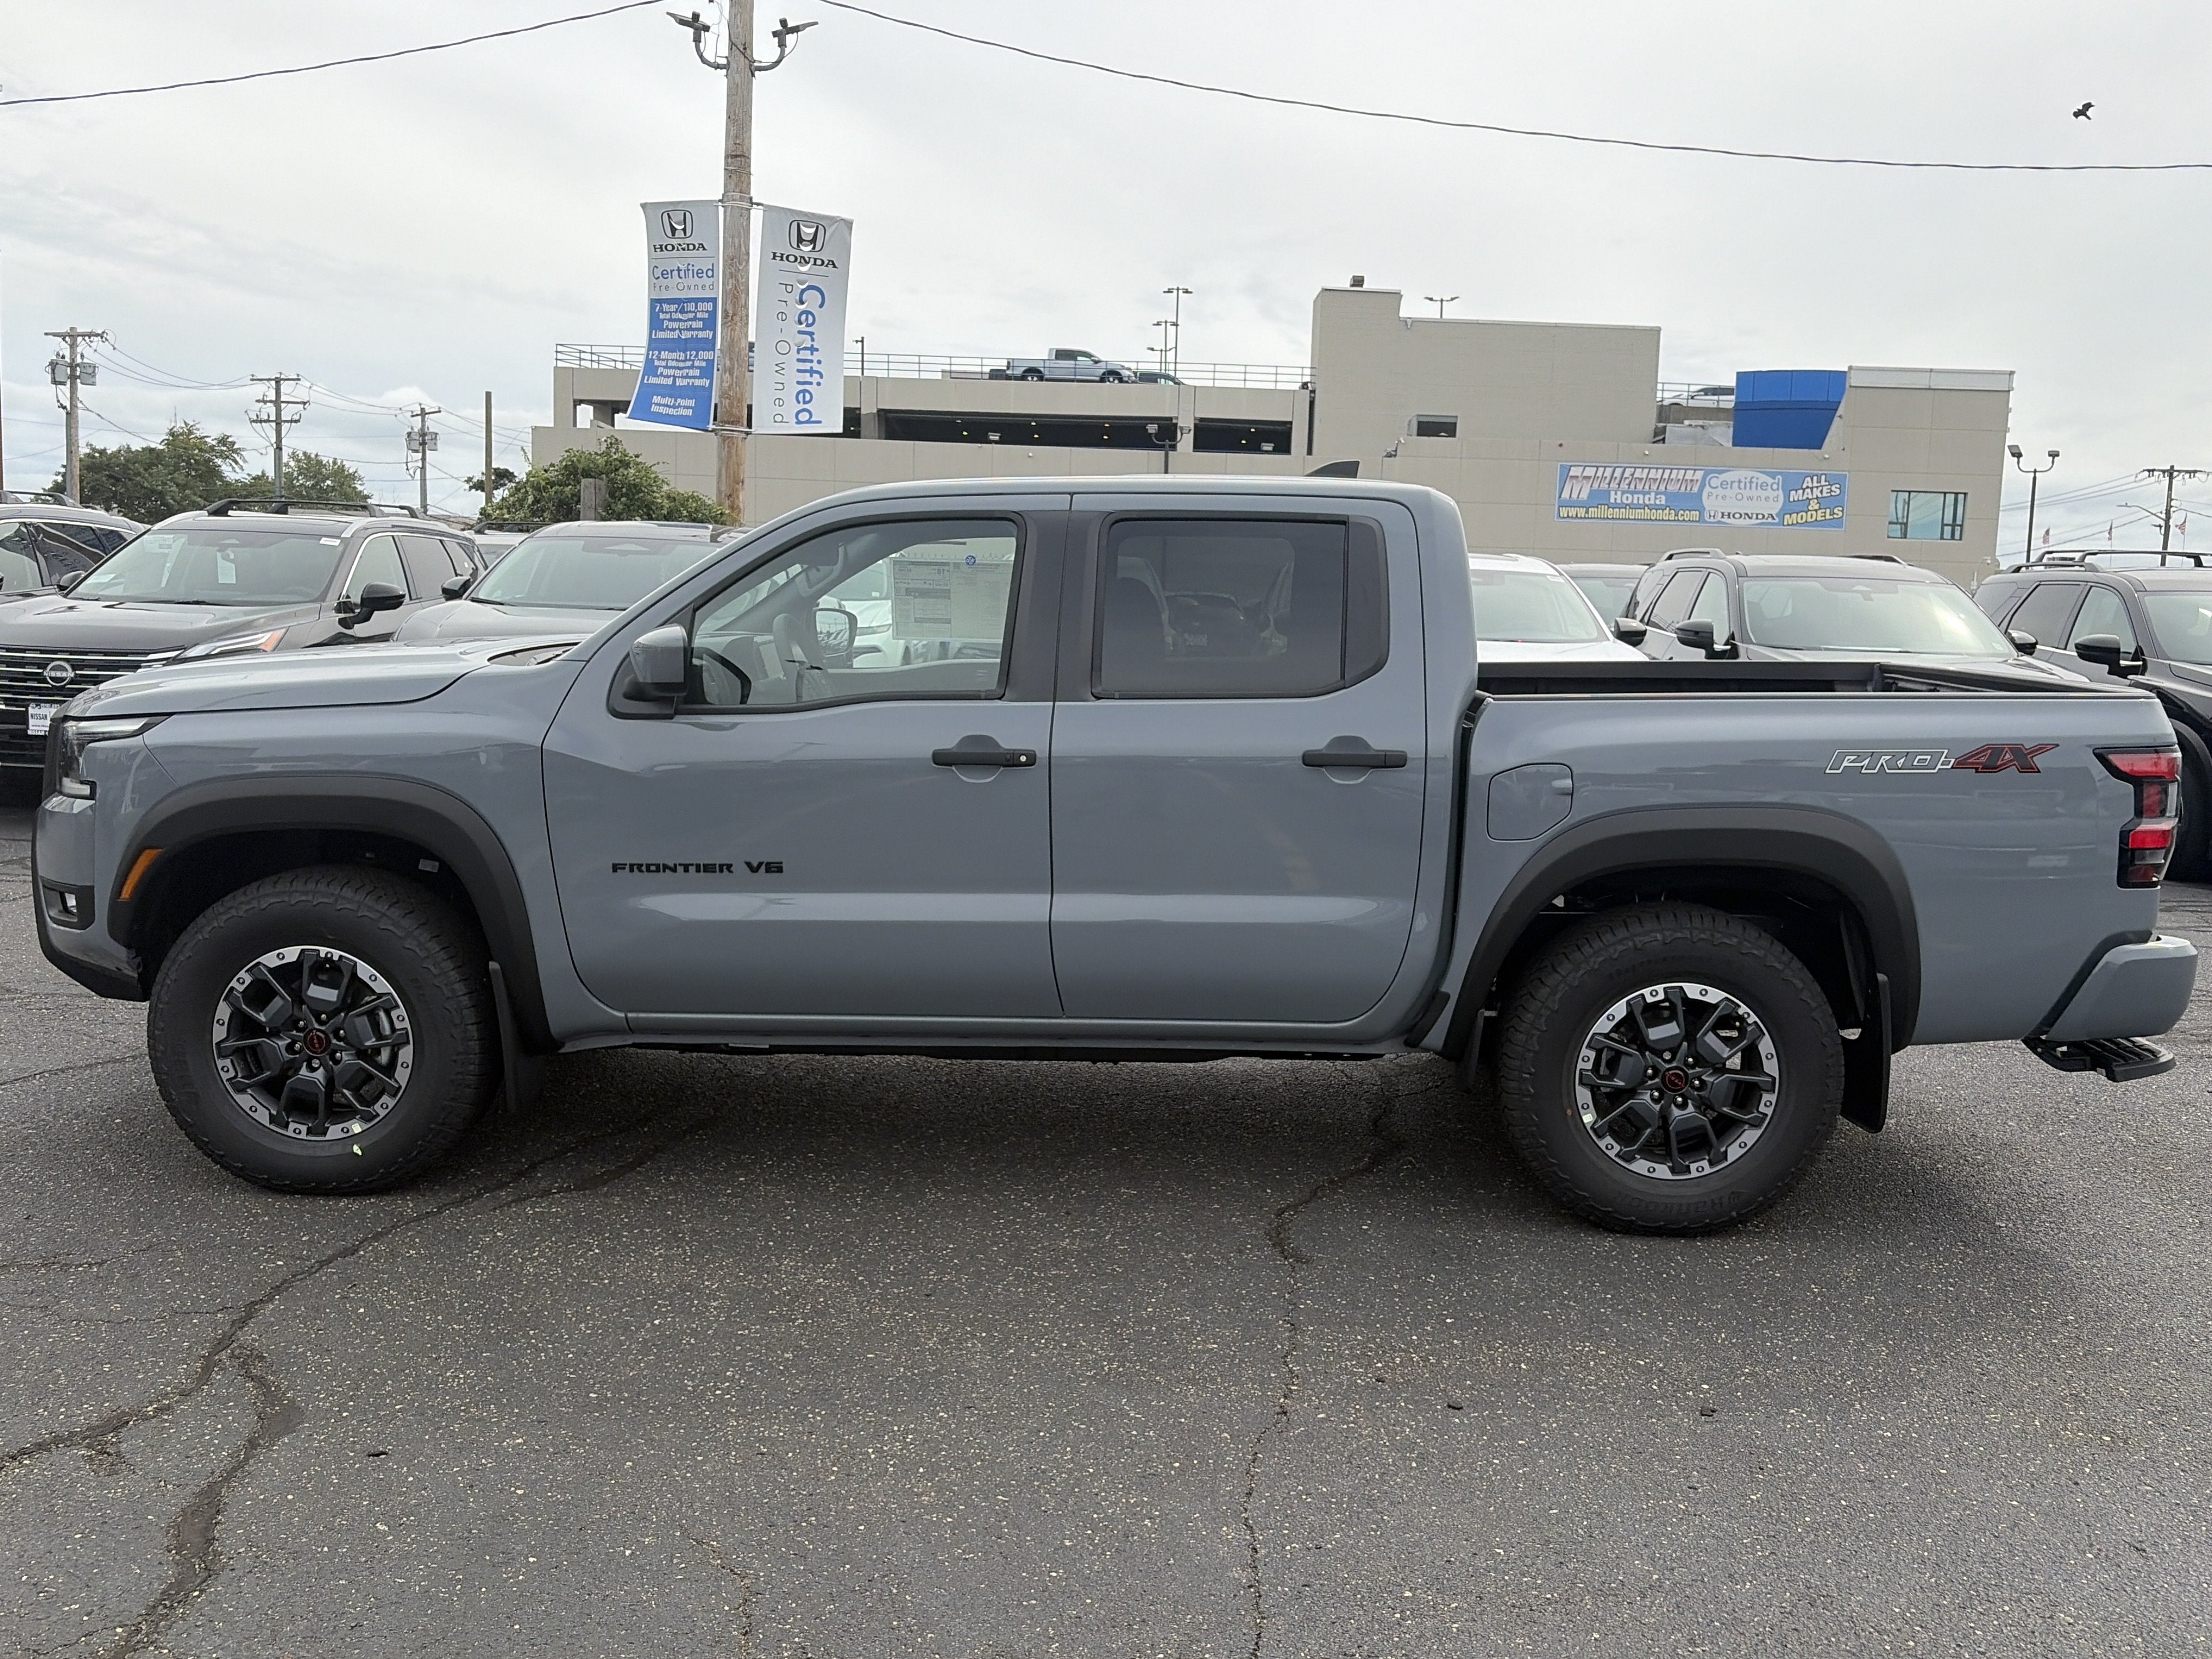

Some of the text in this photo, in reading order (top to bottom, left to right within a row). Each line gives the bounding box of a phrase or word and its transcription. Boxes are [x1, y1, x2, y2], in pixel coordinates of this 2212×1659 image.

[653, 243, 708, 252] HONDA
[771, 251, 839, 269] HONDA
[652, 263, 714, 280] Certified
[652, 330, 679, 339] Limited
[772, 282, 794, 424] Pre-Owned
[794, 284, 826, 425] Certified
[644, 375, 673, 385] Limited
[652, 395, 696, 407] Multi-Point
[650, 404, 693, 416] Inspection
[1707, 475, 1780, 492] Certified
[1802, 473, 1830, 489] ALL
[1609, 490, 1666, 505] Honda
[1707, 492, 1779, 503] Pre-Owned
[1789, 484, 1841, 503] MAKES
[1808, 498, 1820, 510] &
[1559, 504, 1700, 521] www.millenniumhonda.com
[1720, 511, 1777, 521] HONDA
[1783, 506, 1844, 526] MODELS
[611, 860, 784, 874] FRONTIER V6
